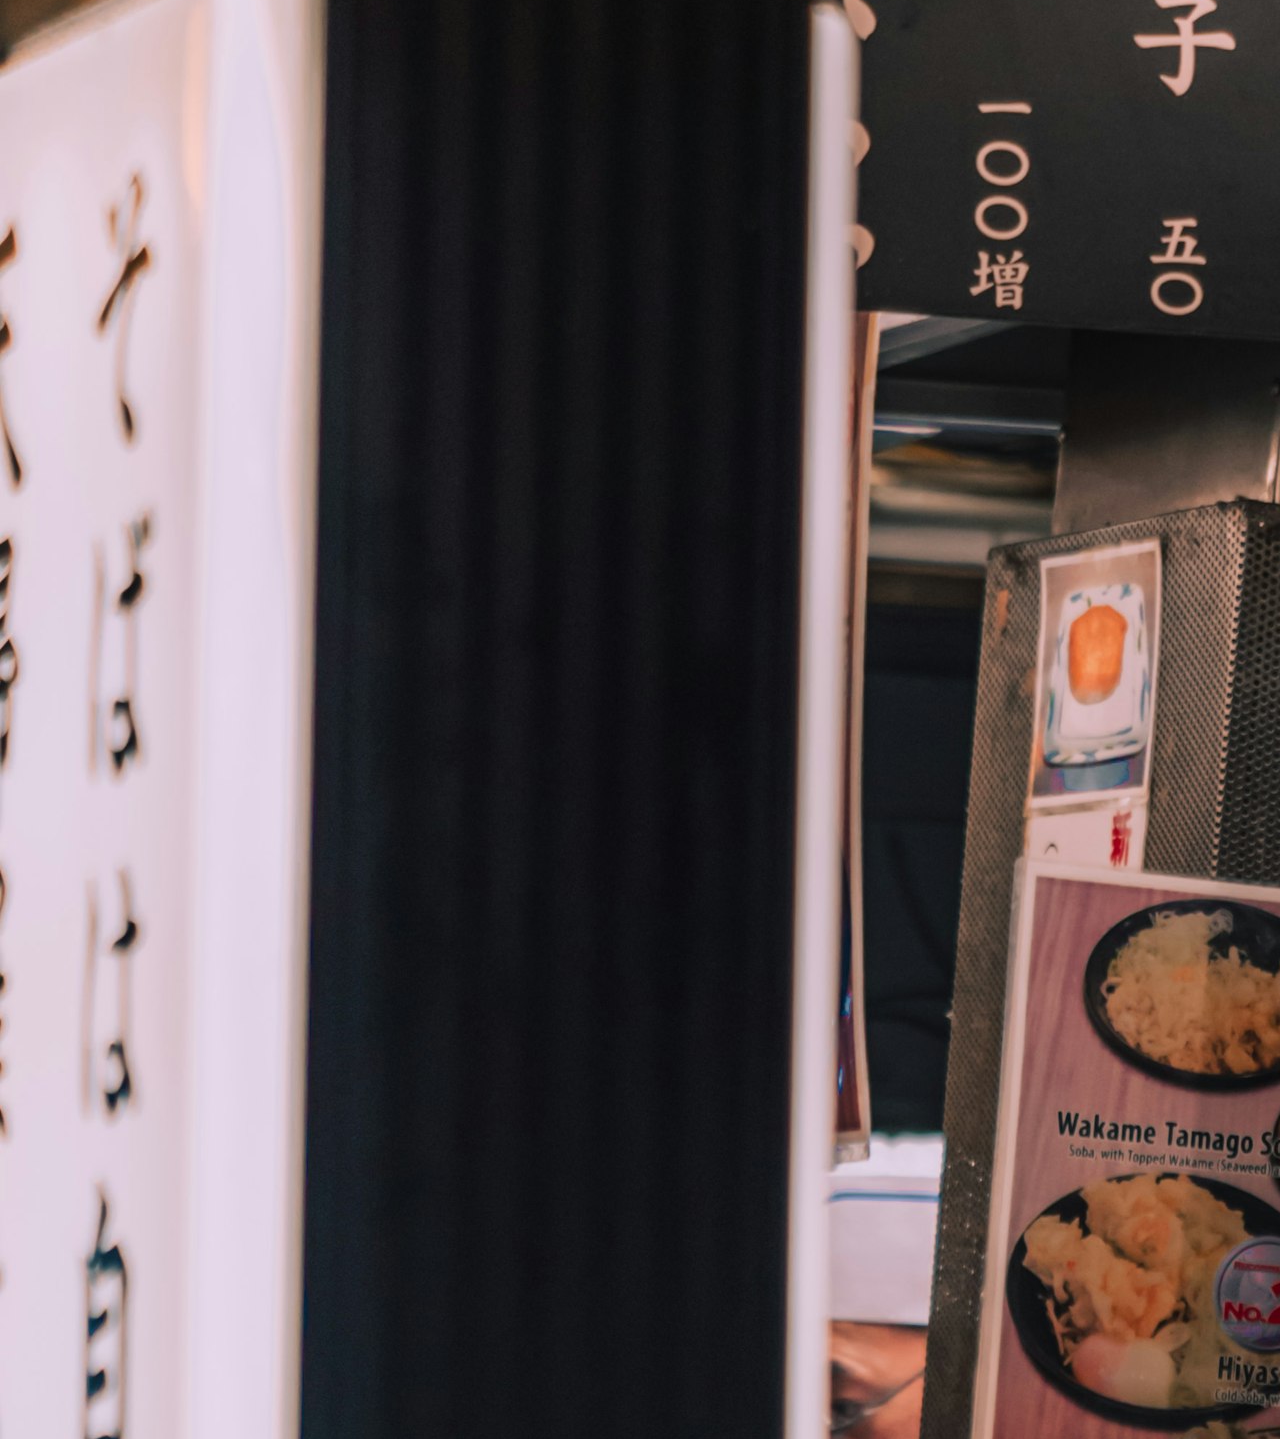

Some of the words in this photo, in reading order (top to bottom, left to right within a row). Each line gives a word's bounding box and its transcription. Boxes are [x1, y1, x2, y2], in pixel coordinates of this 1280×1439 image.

[1149, 217, 1207, 317] 五〇
[1057, 1111, 1156, 1145] Wakame
[1165, 1122, 1253, 1158] Tamago
[1101, 1148, 1125, 1162] with
[1128, 1149, 1166, 1166] Topped
[1169, 1154, 1214, 1170] Wakame
[1216, 1158, 1271, 1176] (Seaweed)
[1215, 1388, 1238, 1403] Cold
